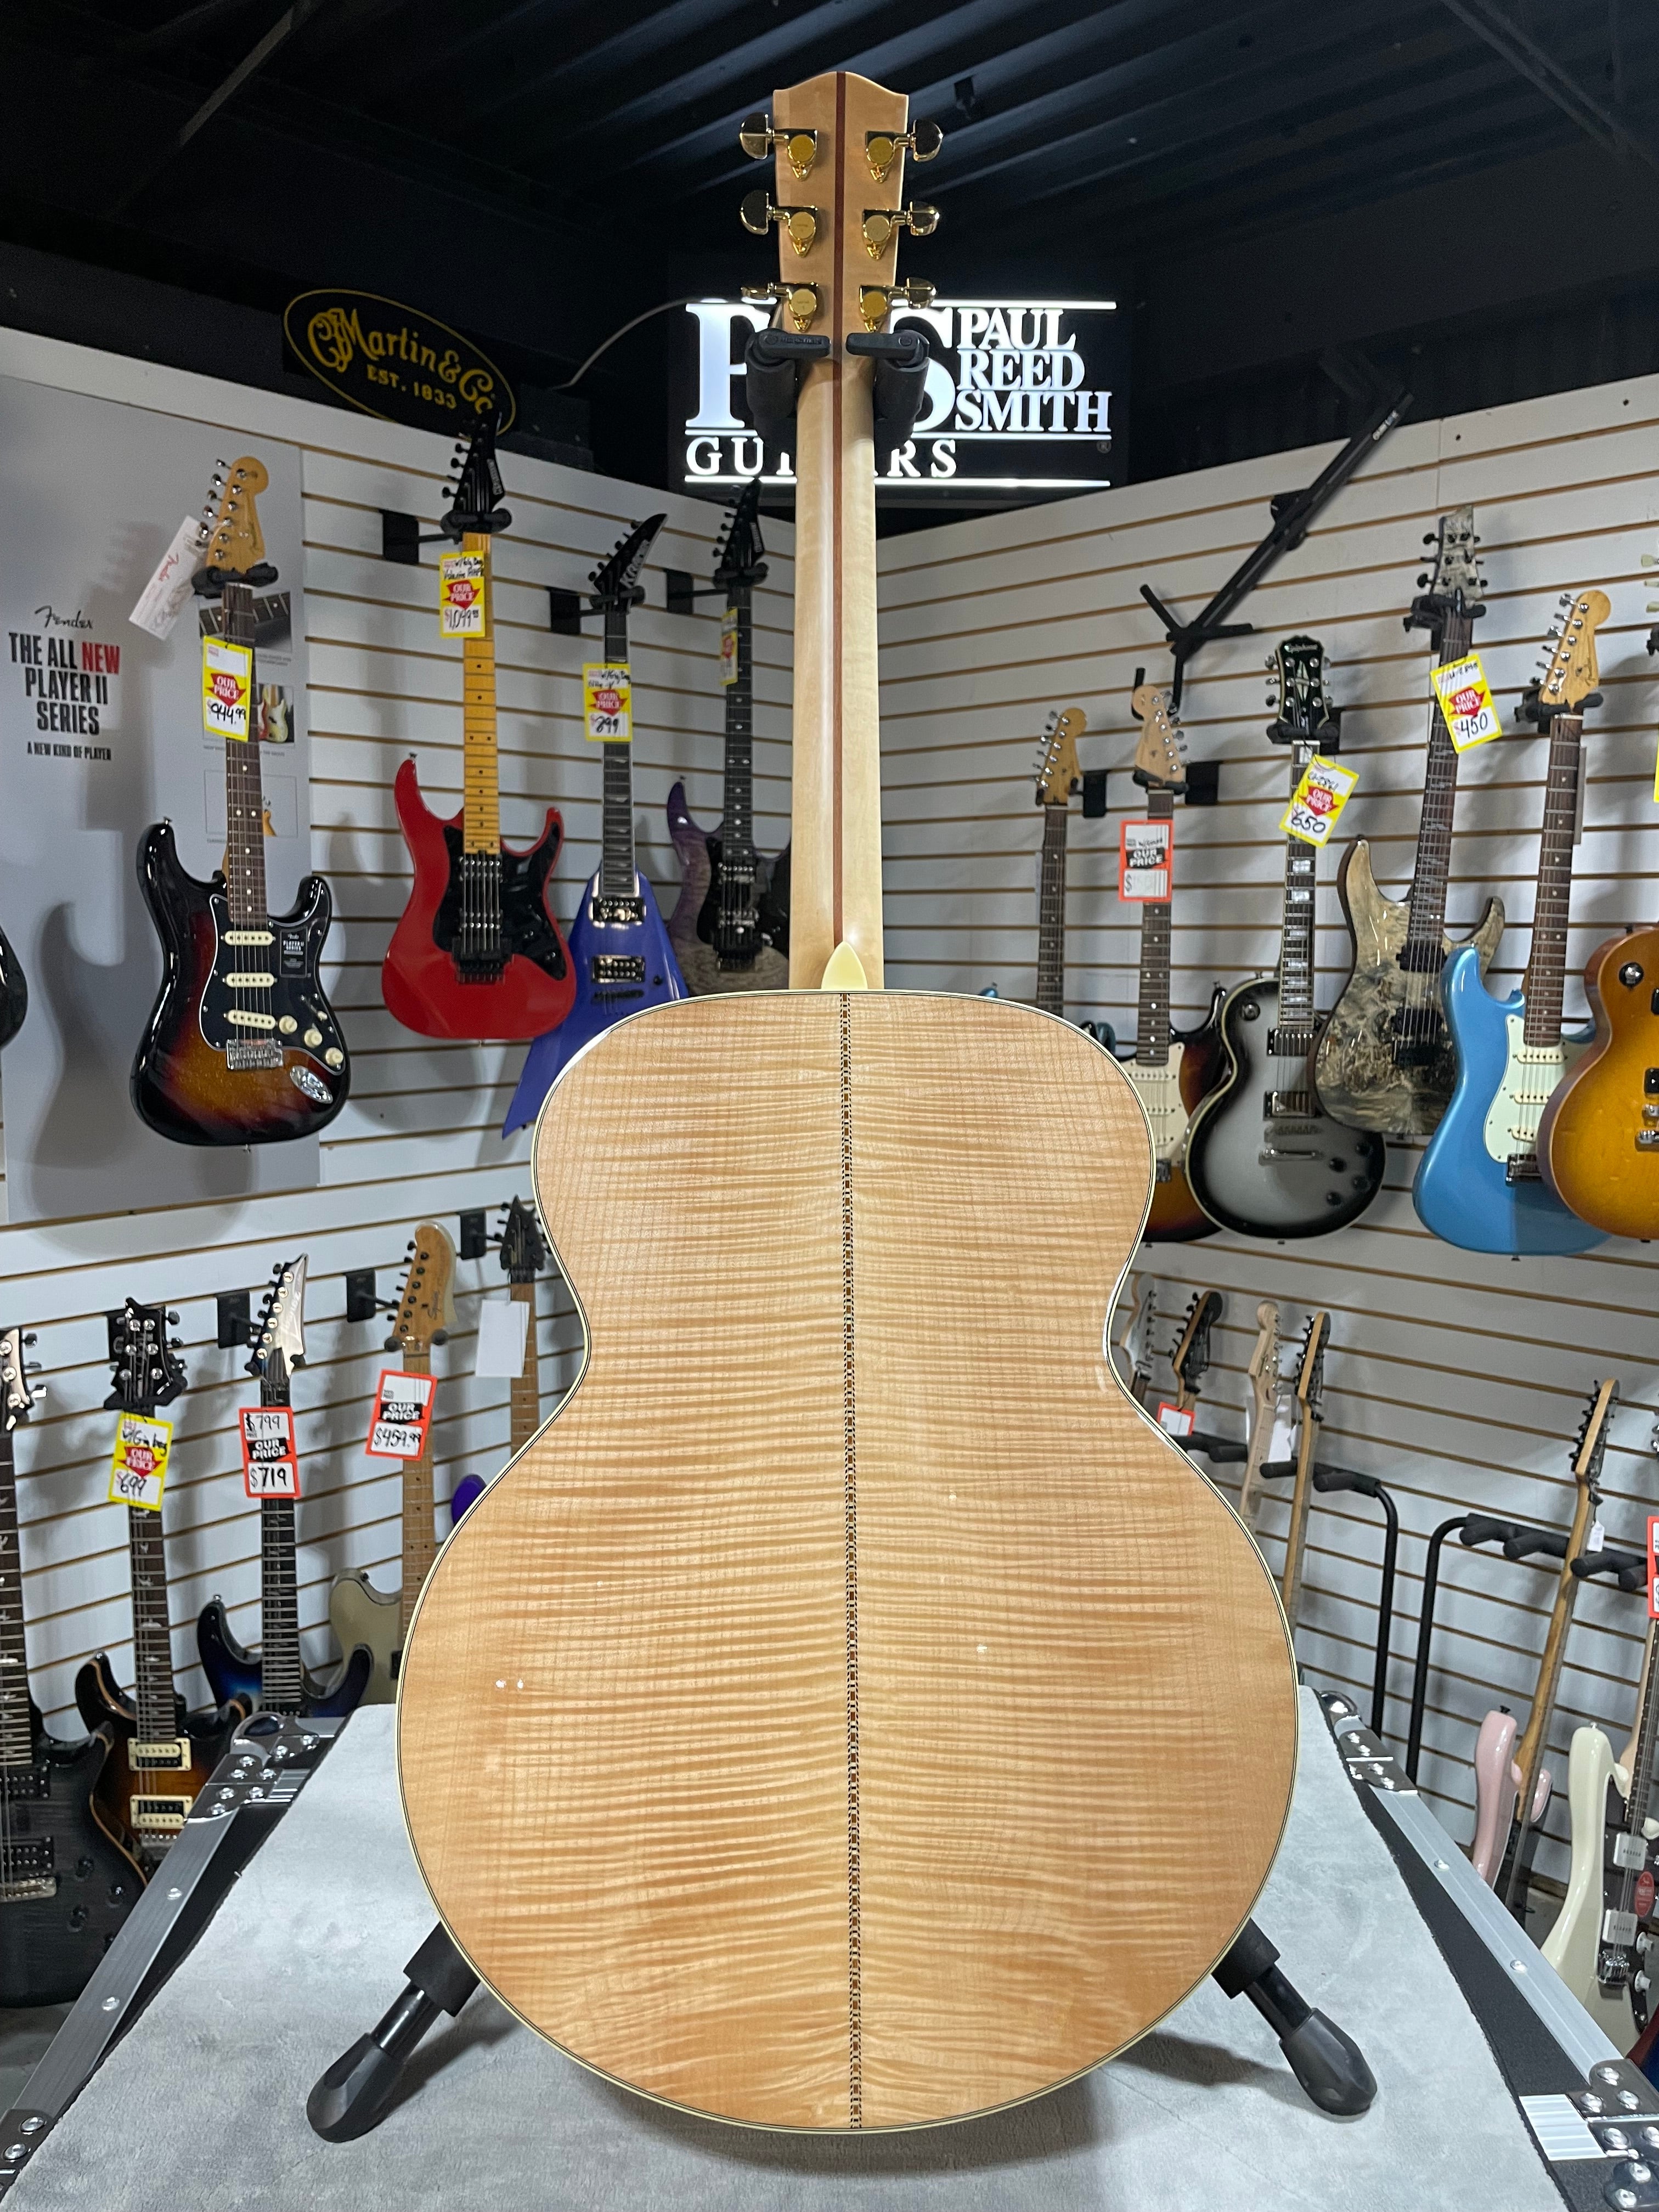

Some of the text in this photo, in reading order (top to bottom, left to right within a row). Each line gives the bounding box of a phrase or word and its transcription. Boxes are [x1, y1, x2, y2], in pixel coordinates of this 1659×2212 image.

[957, 307, 1076, 351] PAUL
[686, 303, 956, 432] PS
[957, 349, 1085, 391] REED
[955, 390, 1113, 432] SMITH
[686, 437, 956, 477] GUIRS
[453, 584, 472, 593] OUR
[450, 591, 475, 602] PRICE
[35, 605, 93, 629] Fender
[9, 633, 120, 675] THE ALL NEW
[25, 666, 108, 704] PLAYER II
[217, 675, 236, 689] OUR
[213, 684, 240, 701] PRICE
[599, 692, 618, 701] OUR
[1455, 689, 1476, 704] OUR
[596, 700, 620, 709] PRICE
[1455, 697, 1480, 715] PRICE
[37, 701, 99, 736] SERIES
[34, 742, 51, 756] NEW
[53, 743, 72, 758] KIND
[74, 745, 82, 758] OF
[84, 746, 111, 761] PLAYER
[1306, 794, 1331, 812] PRICE
[1312, 788, 1332, 803] OUR
[1130, 854, 1163, 867] PRICE
[1133, 849, 1156, 860] OUR
[382, 1410, 420, 1420] PRICE
[388, 1403, 415, 1413] OUR
[255, 1438, 280, 1450] OUR
[130, 1448, 153, 1462] OUR
[252, 1446, 286, 1460] PRICE
[126, 1457, 156, 1471] PRICE
[250, 1467, 287, 1488] $719
